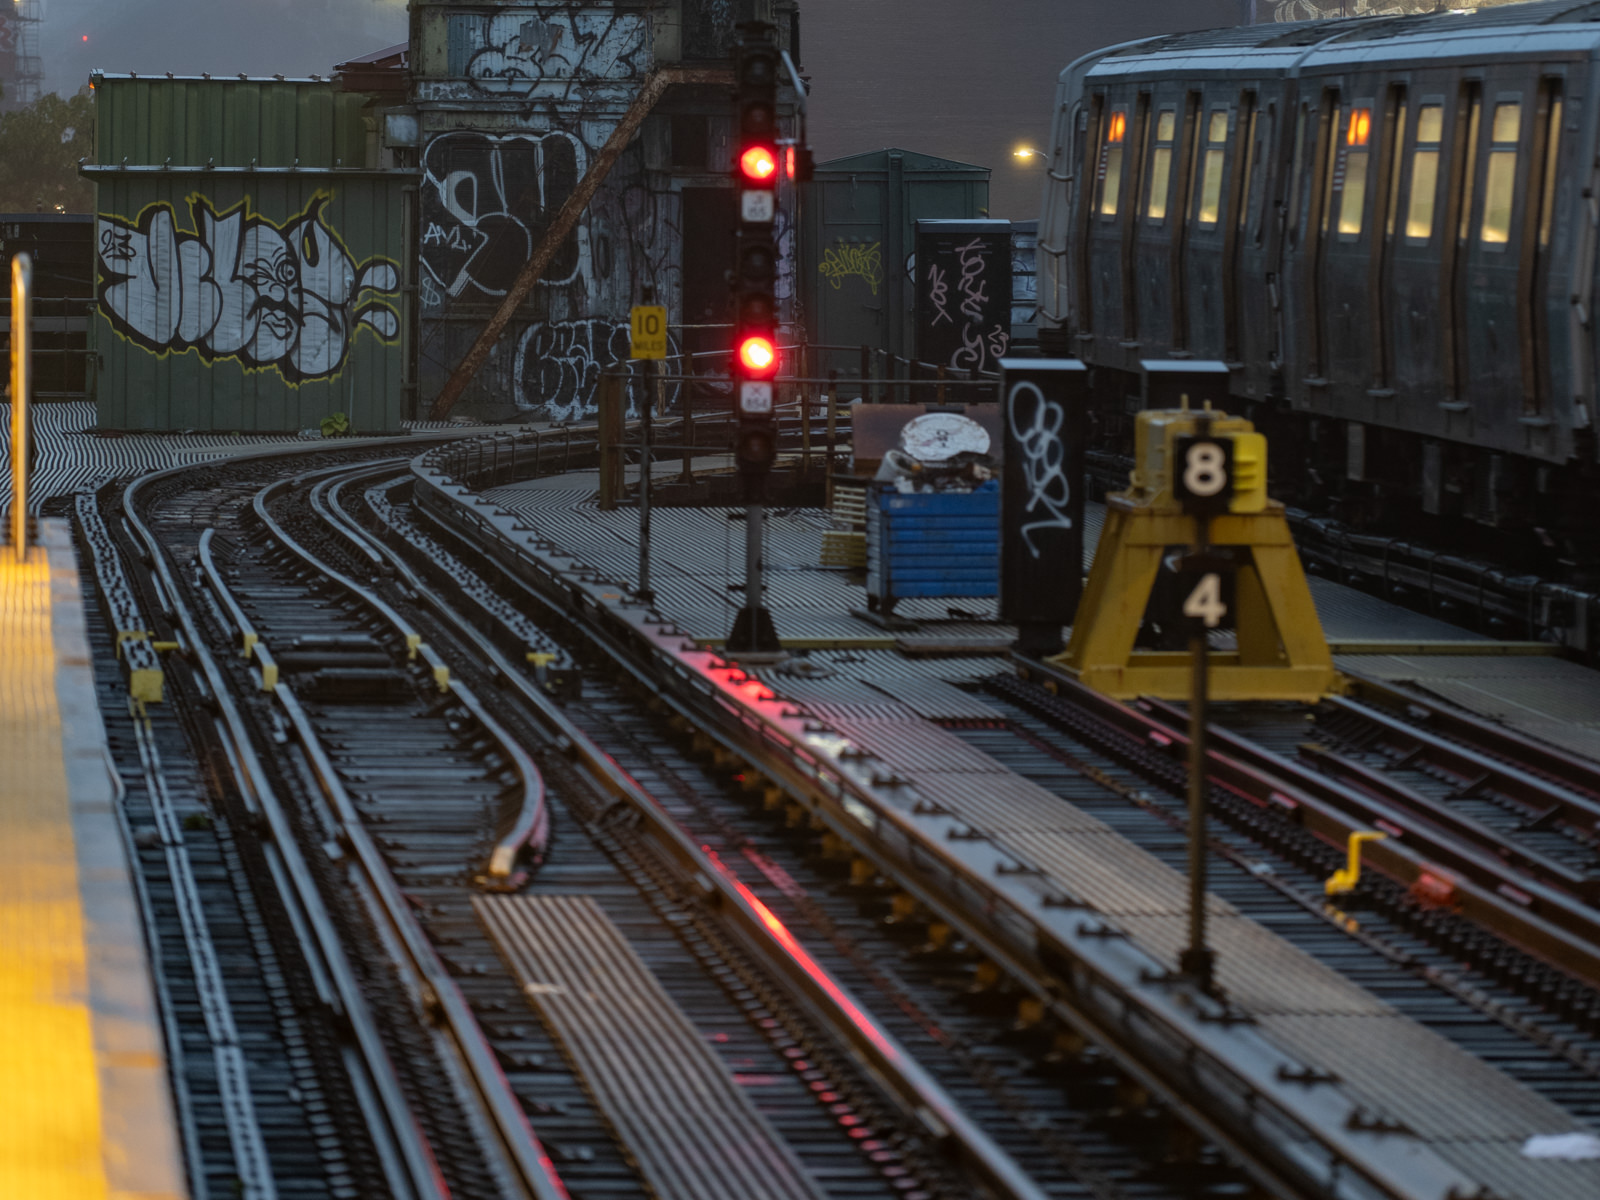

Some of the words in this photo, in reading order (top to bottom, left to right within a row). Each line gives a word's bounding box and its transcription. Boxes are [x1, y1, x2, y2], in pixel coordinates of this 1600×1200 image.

[638, 314, 659, 335] 10
[633, 340, 664, 351] MILES
[1183, 442, 1227, 497] 8
[1182, 572, 1227, 628] 4
